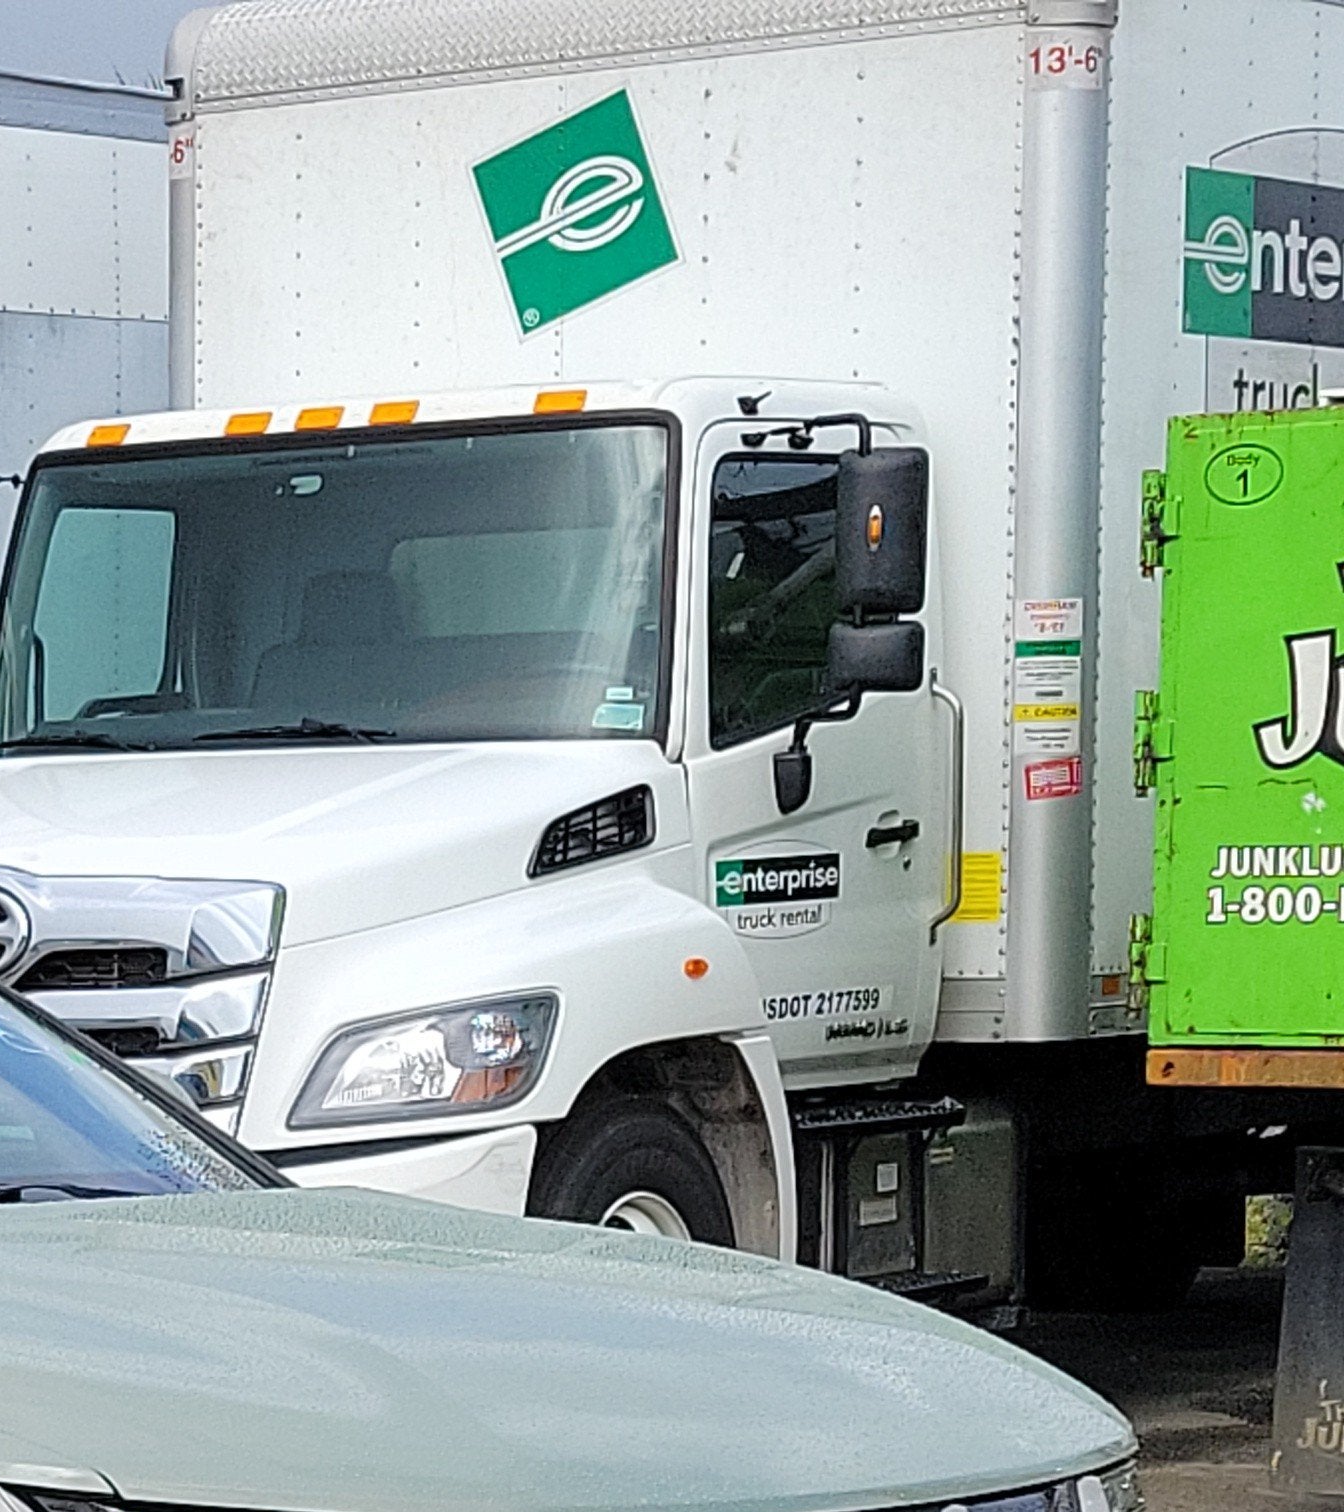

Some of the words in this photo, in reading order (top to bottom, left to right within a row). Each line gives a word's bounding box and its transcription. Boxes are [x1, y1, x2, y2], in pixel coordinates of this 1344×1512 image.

[1184, 215, 1344, 300] ente
[1236, 469, 1248, 497] 1
[1252, 628, 1344, 770] J
[716, 860, 839, 896] enterprise
[1210, 845, 1344, 879] JUNKLU
[737, 907, 776, 930] truck
[780, 903, 823, 926] rental
[1206, 885, 1344, 925] 1-800-
[816, 988, 880, 1015] 2177599
[1296, 1418, 1344, 1453] JU
